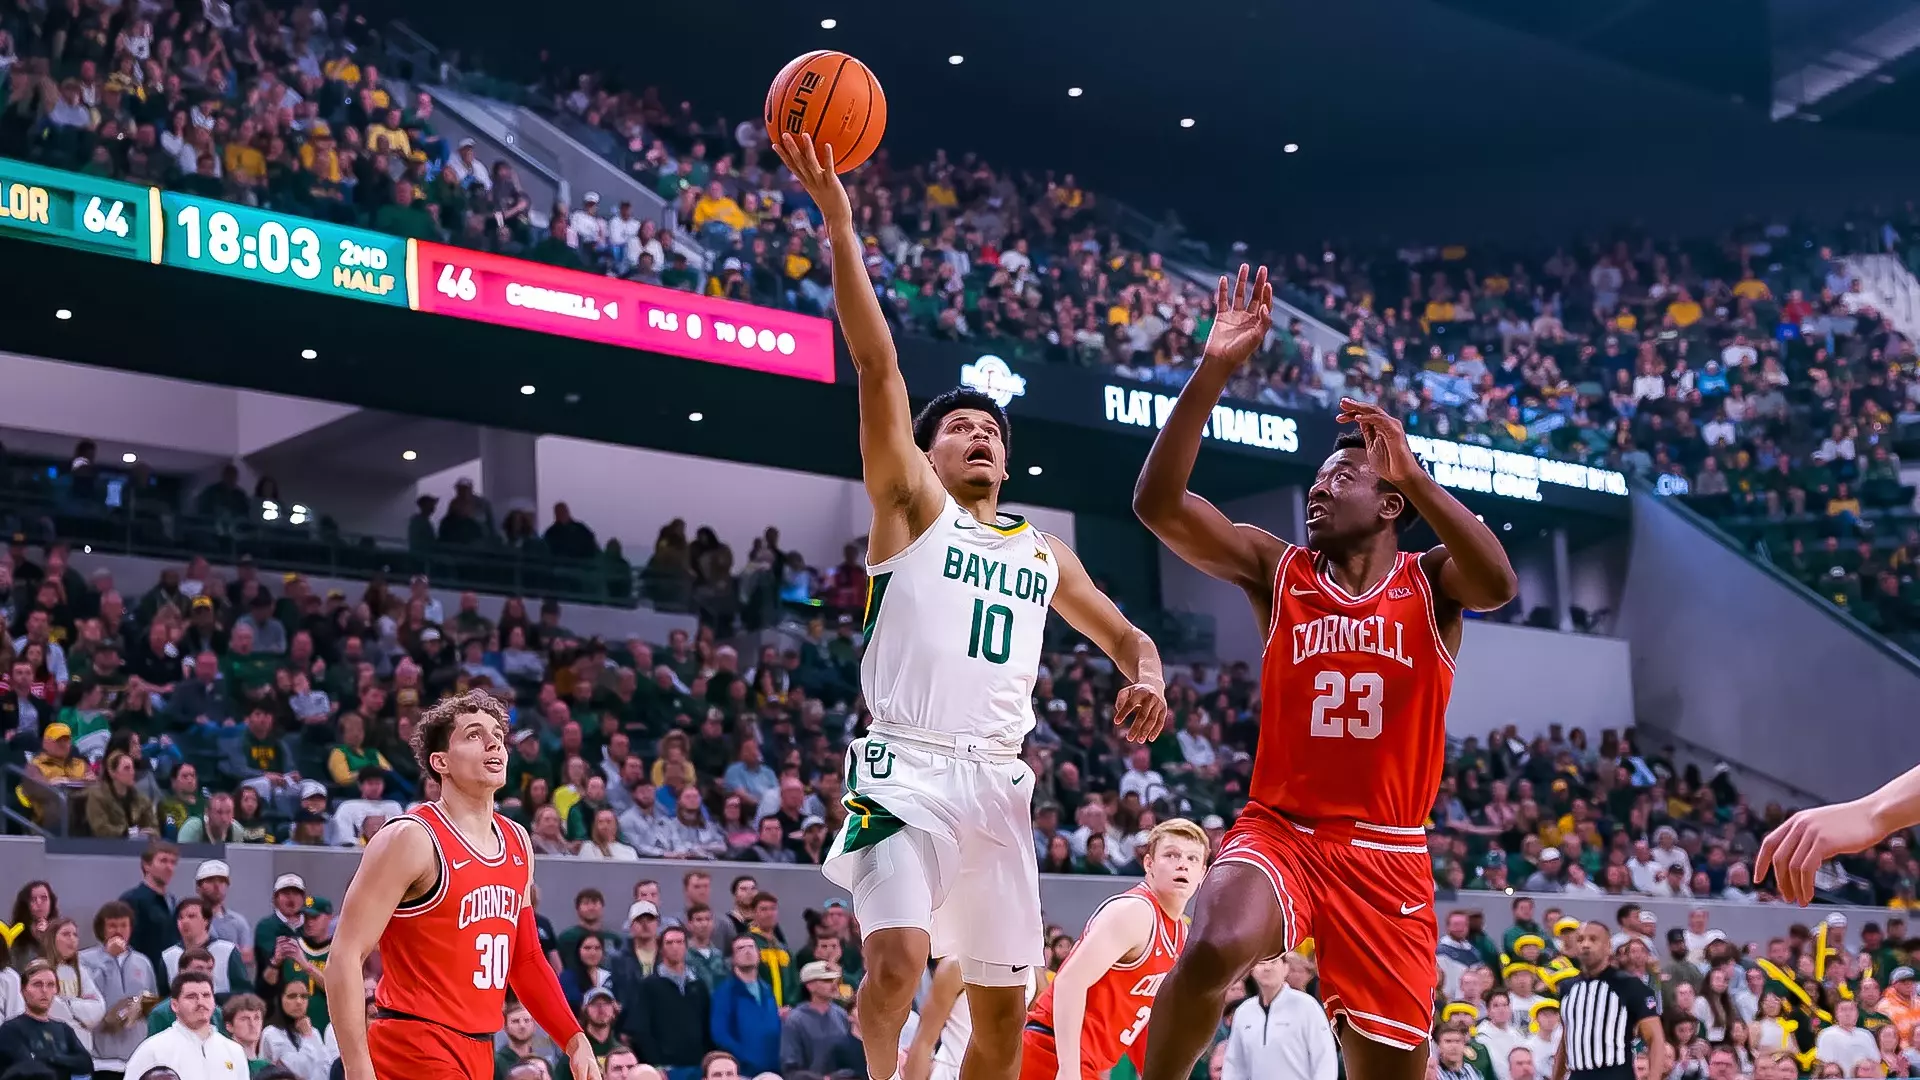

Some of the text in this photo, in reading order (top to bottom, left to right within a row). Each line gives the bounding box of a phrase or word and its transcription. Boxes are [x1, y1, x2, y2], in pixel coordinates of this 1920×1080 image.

[83, 196, 129, 238] 64
[177, 205, 322, 280] 18:03
[333, 266, 395, 295] HALF
[338, 239, 388, 270] 2ND
[436, 264, 477, 301] 46
[1104, 385, 1153, 427] FLAT
[1211, 404, 1299, 453] TRAILERS
[943, 546, 1047, 607] BAYLOR
[968, 598, 1014, 664] 10
[1292, 615, 1413, 669] CORNELL
[1311, 671, 1384, 739] 23
[472, 933, 509, 990] 30
